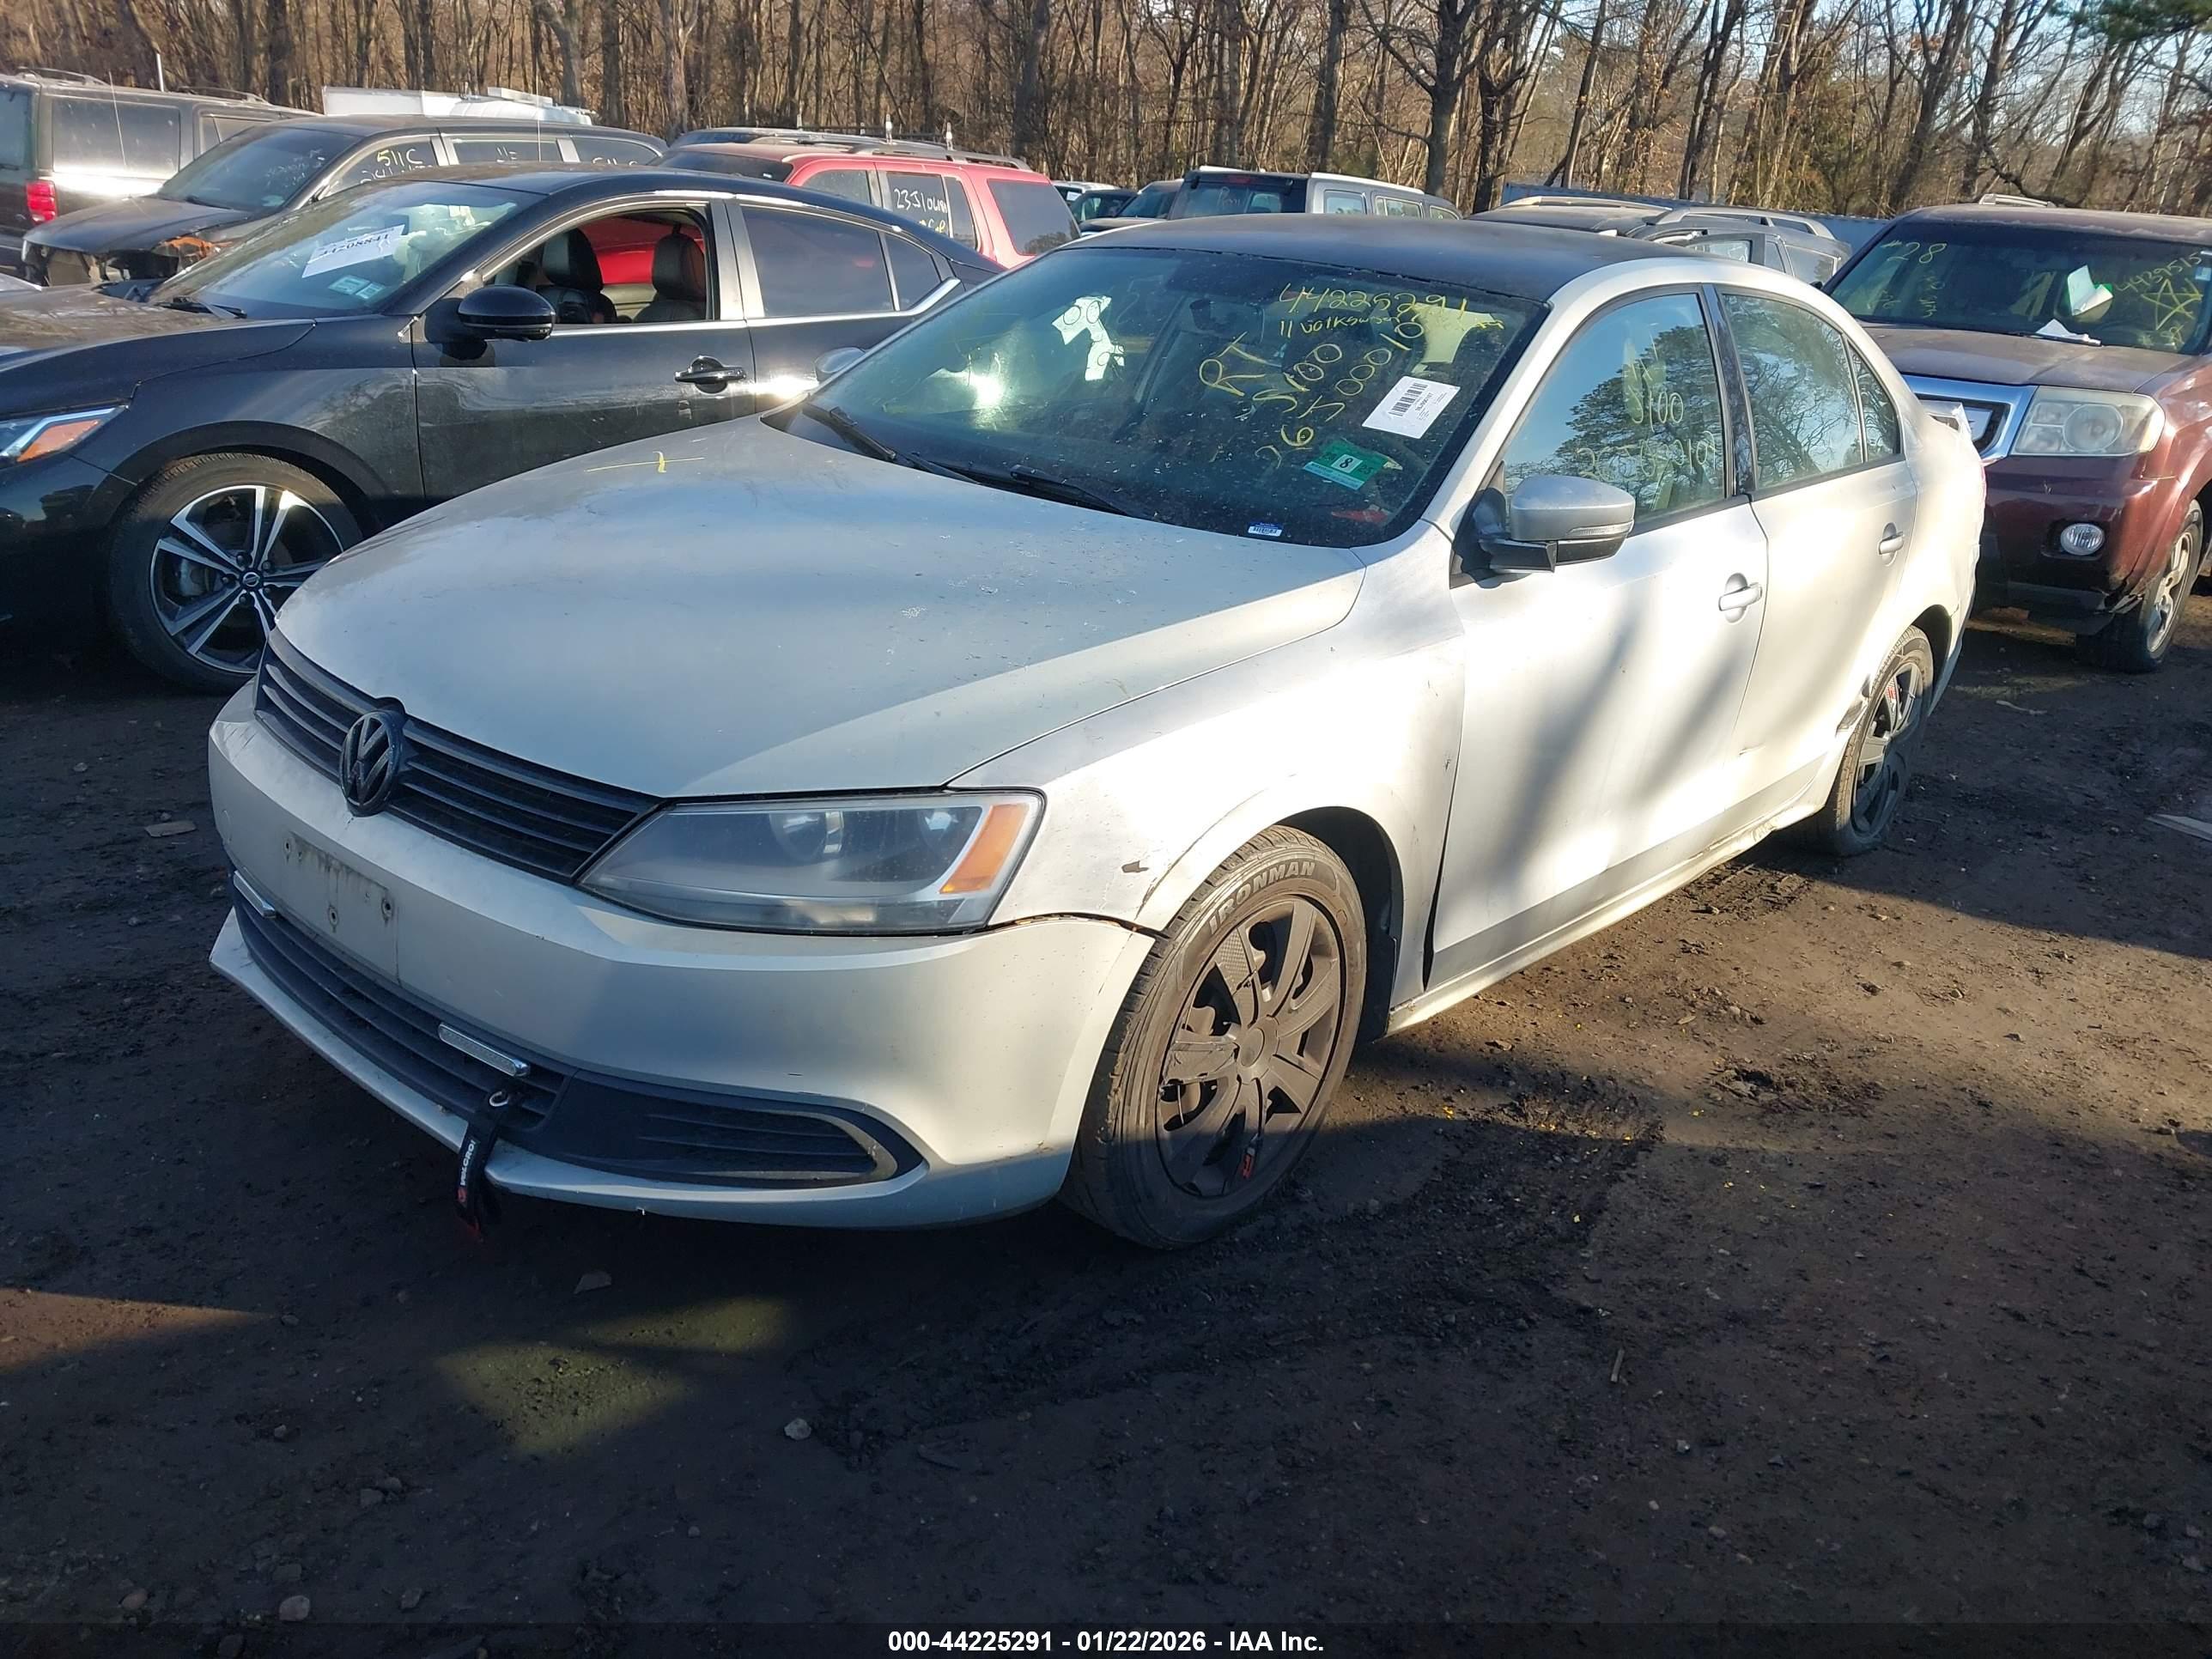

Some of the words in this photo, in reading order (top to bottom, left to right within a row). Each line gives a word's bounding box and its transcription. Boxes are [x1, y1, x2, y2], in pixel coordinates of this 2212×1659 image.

[1279, 283, 1468, 319] 44225291
[1340, 458, 1353, 468] 8
[1209, 861, 1316, 935] IRONMAN
